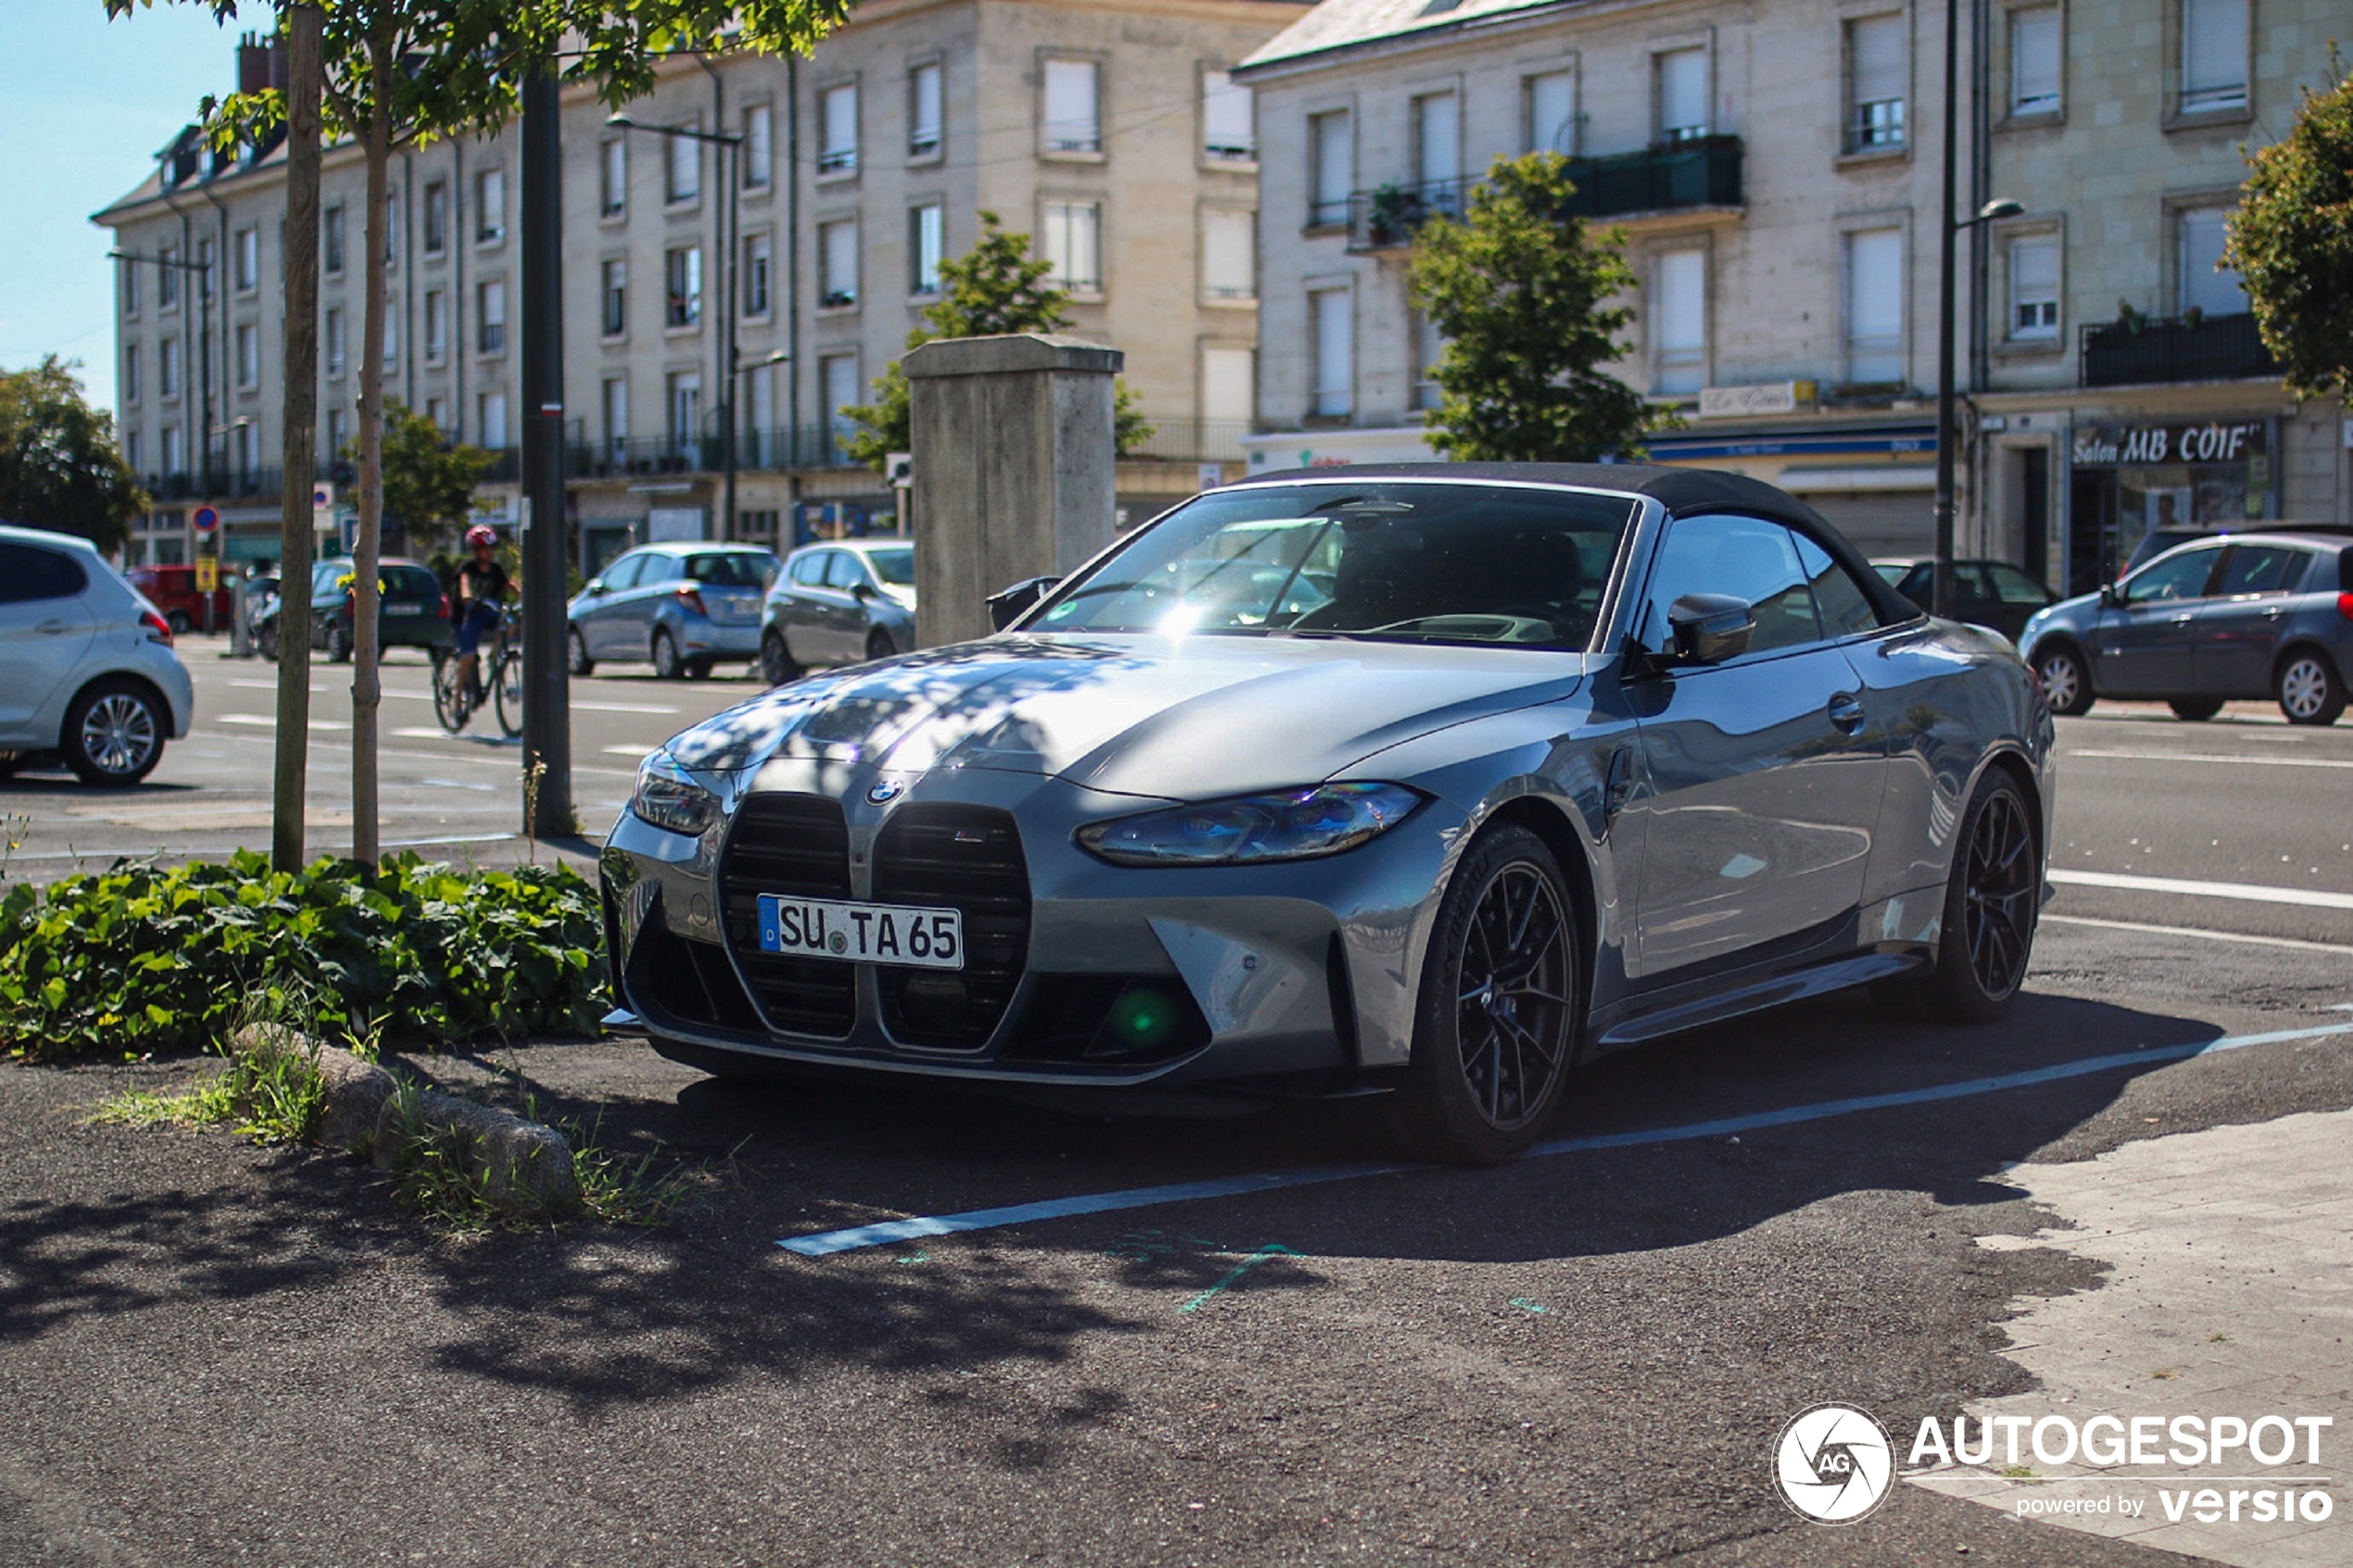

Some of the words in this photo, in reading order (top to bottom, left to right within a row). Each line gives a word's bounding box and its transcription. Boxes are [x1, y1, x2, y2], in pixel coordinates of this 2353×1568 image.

[2072, 437, 2118, 464] Salon
[766, 928, 774, 942] D
[781, 905, 826, 950] SU
